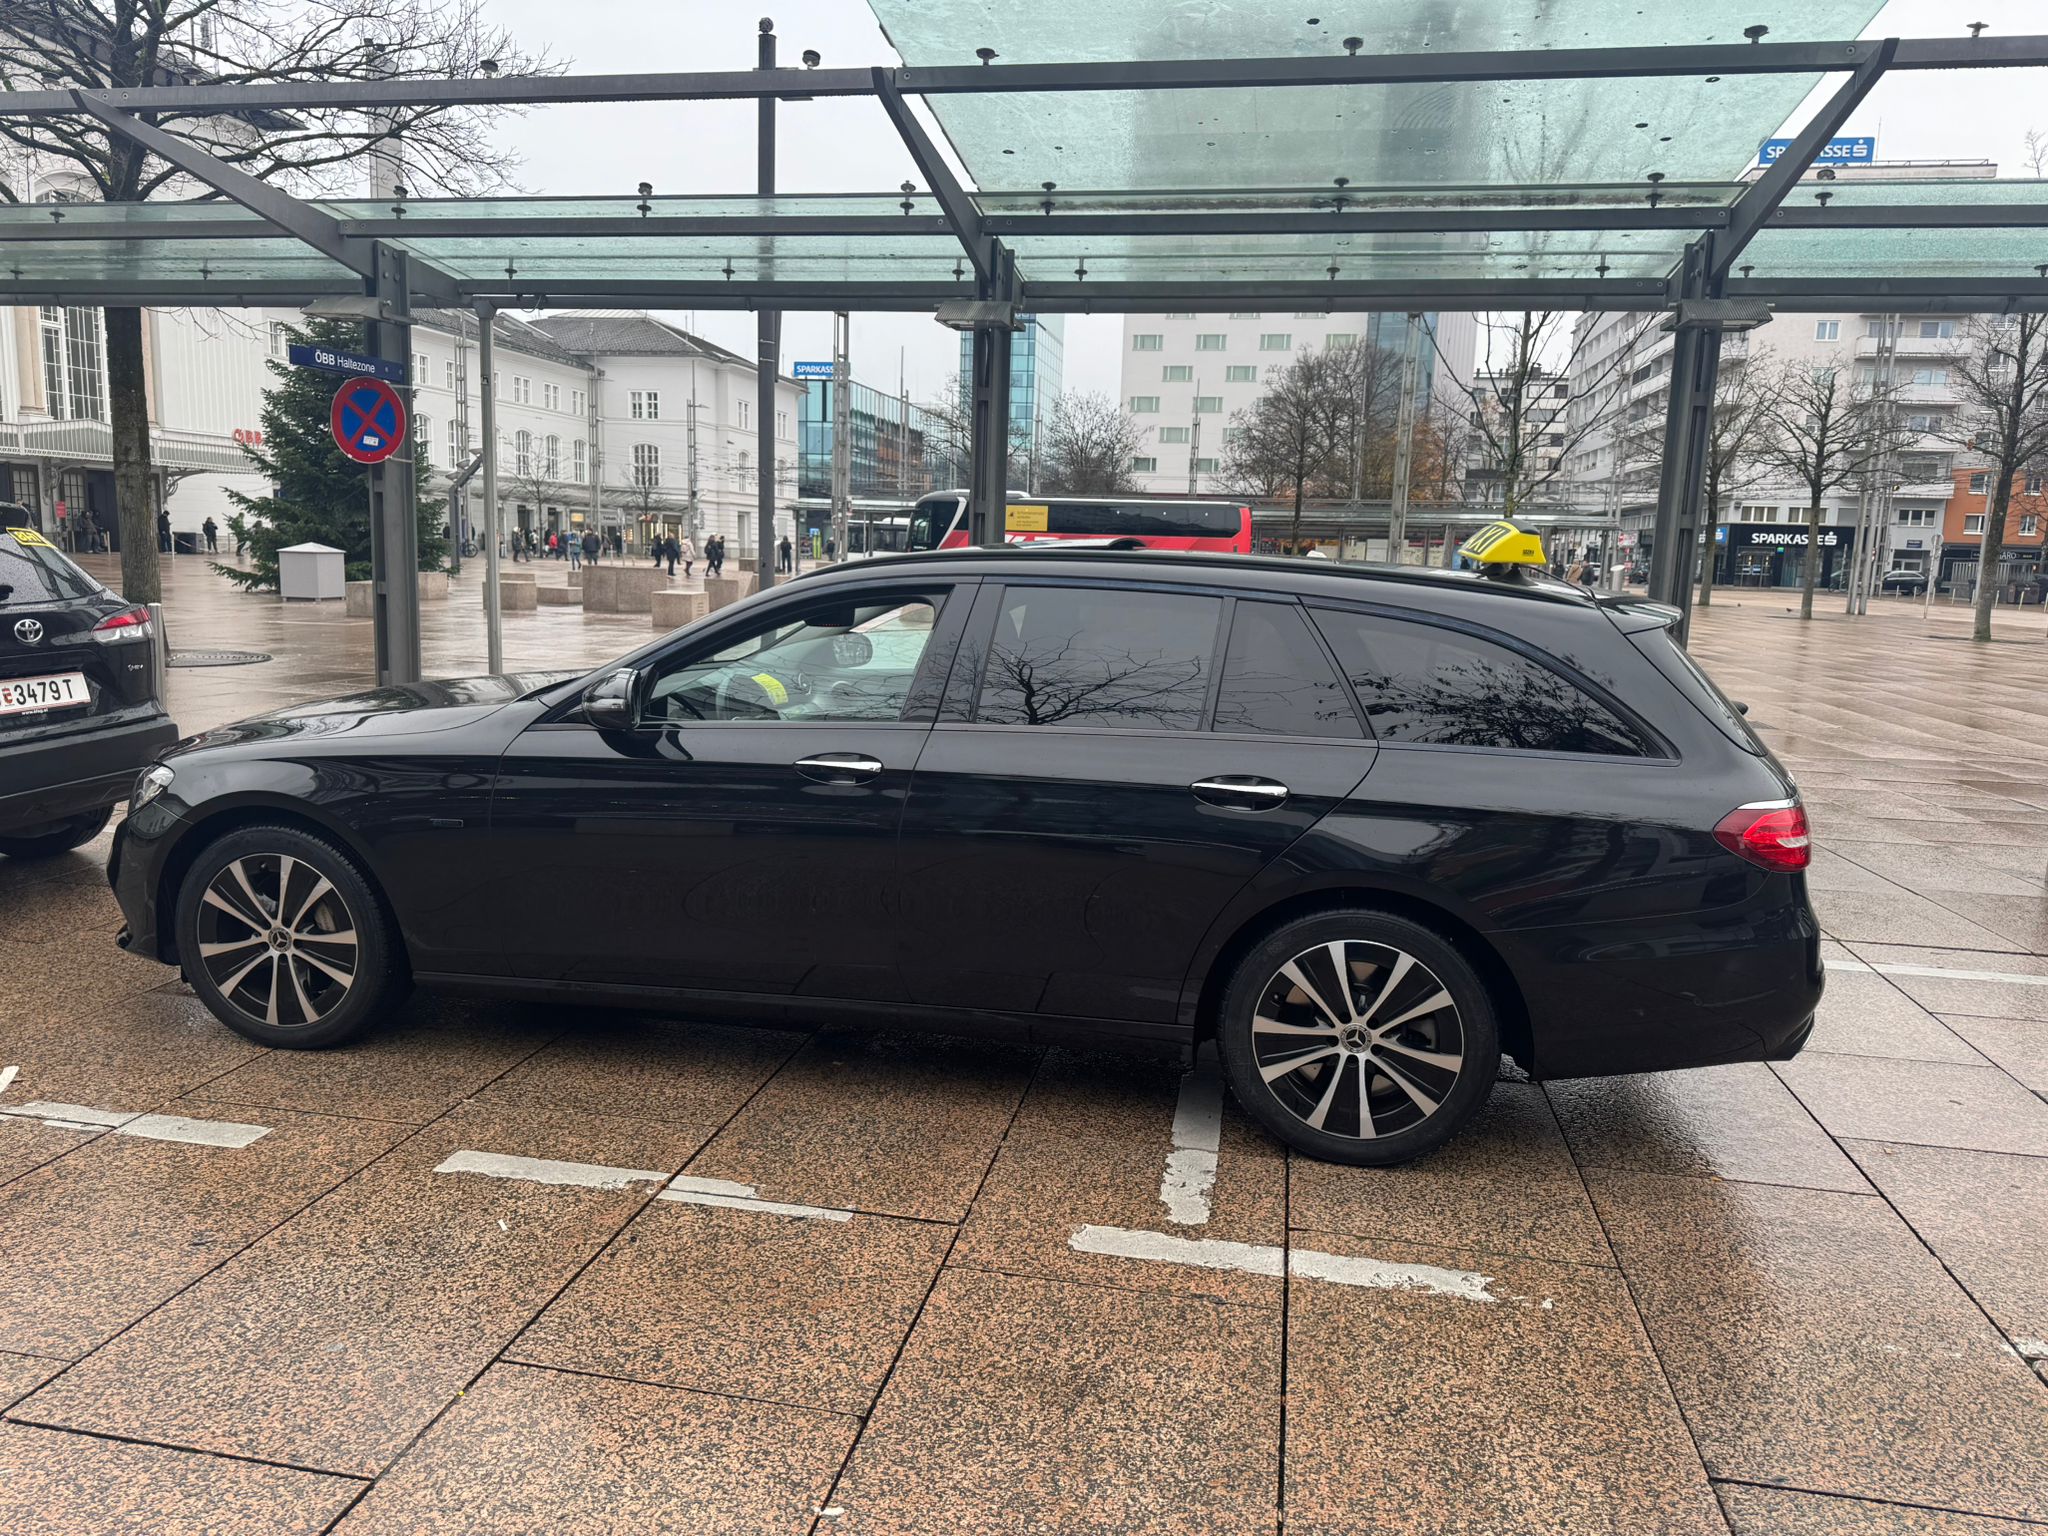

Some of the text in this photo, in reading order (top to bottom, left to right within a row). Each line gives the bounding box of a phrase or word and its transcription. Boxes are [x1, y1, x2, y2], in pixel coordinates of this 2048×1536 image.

[1766, 144, 1851, 159] SPSSE
[314, 349, 376, 373] ÖBB Haltezone
[796, 364, 834, 374] SPARKASS
[1751, 533, 1825, 546] SPARKASE
